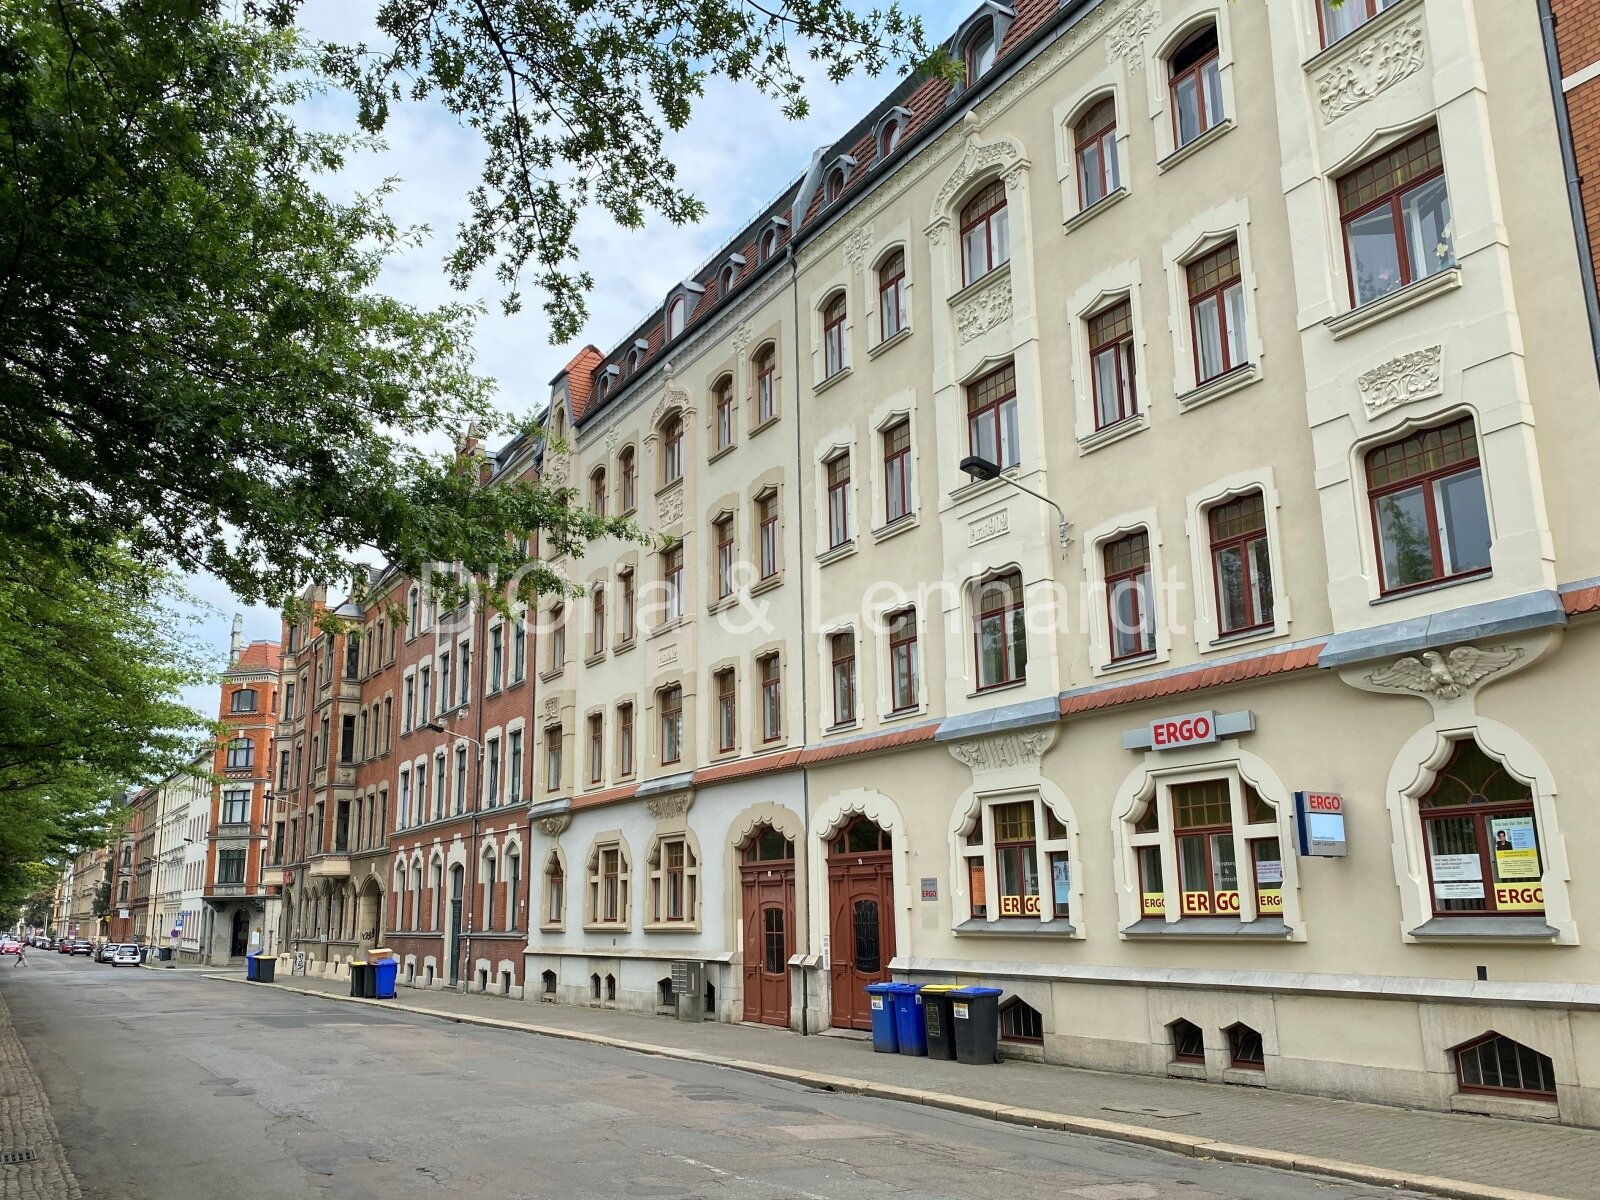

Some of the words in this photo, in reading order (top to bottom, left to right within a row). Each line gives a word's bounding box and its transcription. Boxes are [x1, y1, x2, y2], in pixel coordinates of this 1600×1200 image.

[1153, 717, 1210, 745] ERGO
[1310, 795, 1340, 810] ERGO
[1260, 896, 1282, 906] ERG
